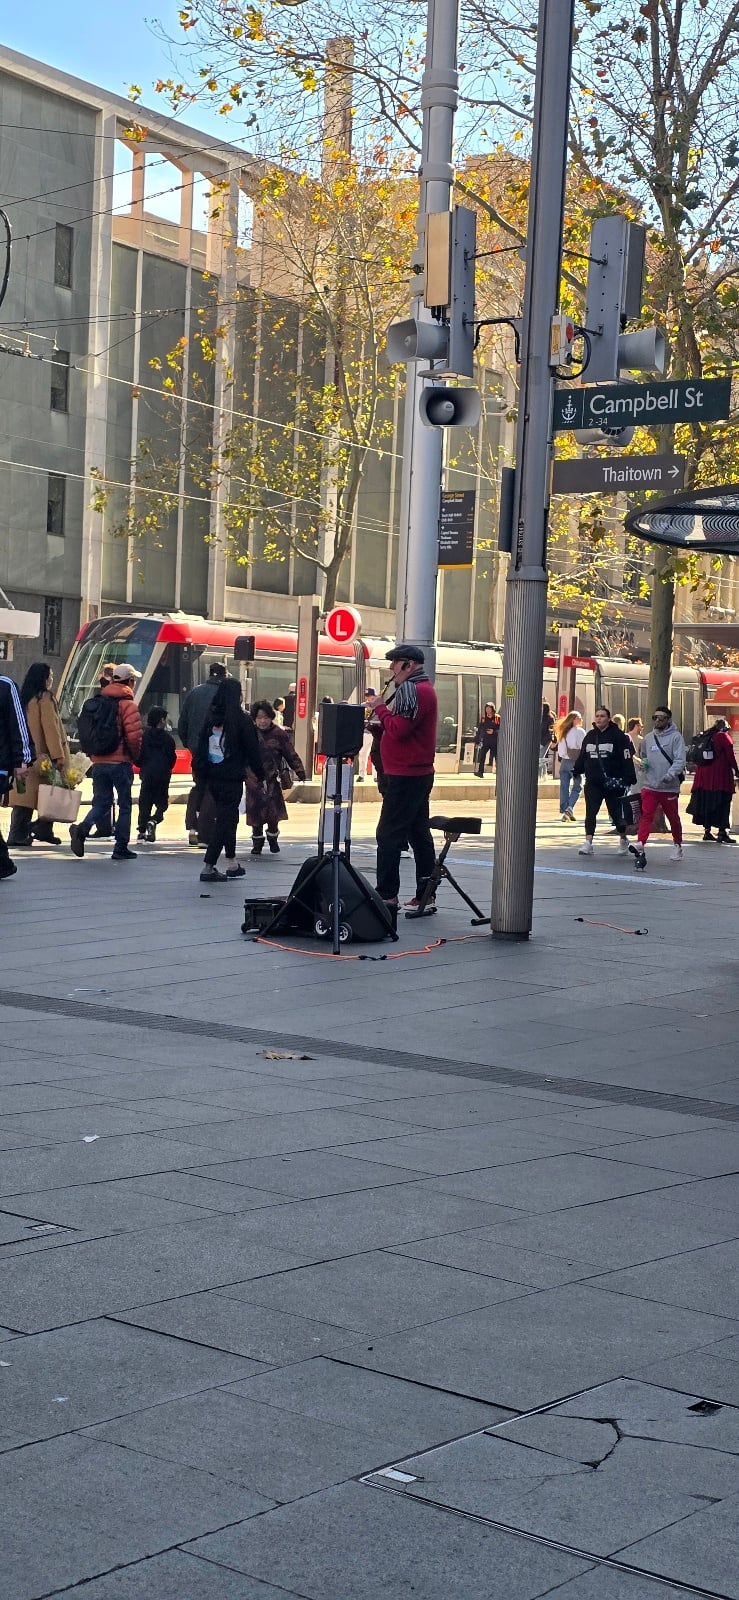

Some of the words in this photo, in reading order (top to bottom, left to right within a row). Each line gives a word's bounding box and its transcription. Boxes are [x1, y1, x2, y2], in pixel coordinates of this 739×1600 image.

[589, 388, 679, 418] Campbell
[684, 387, 704, 408] St
[602, 466, 662, 483] Thaitown
[335, 614, 348, 636] L
